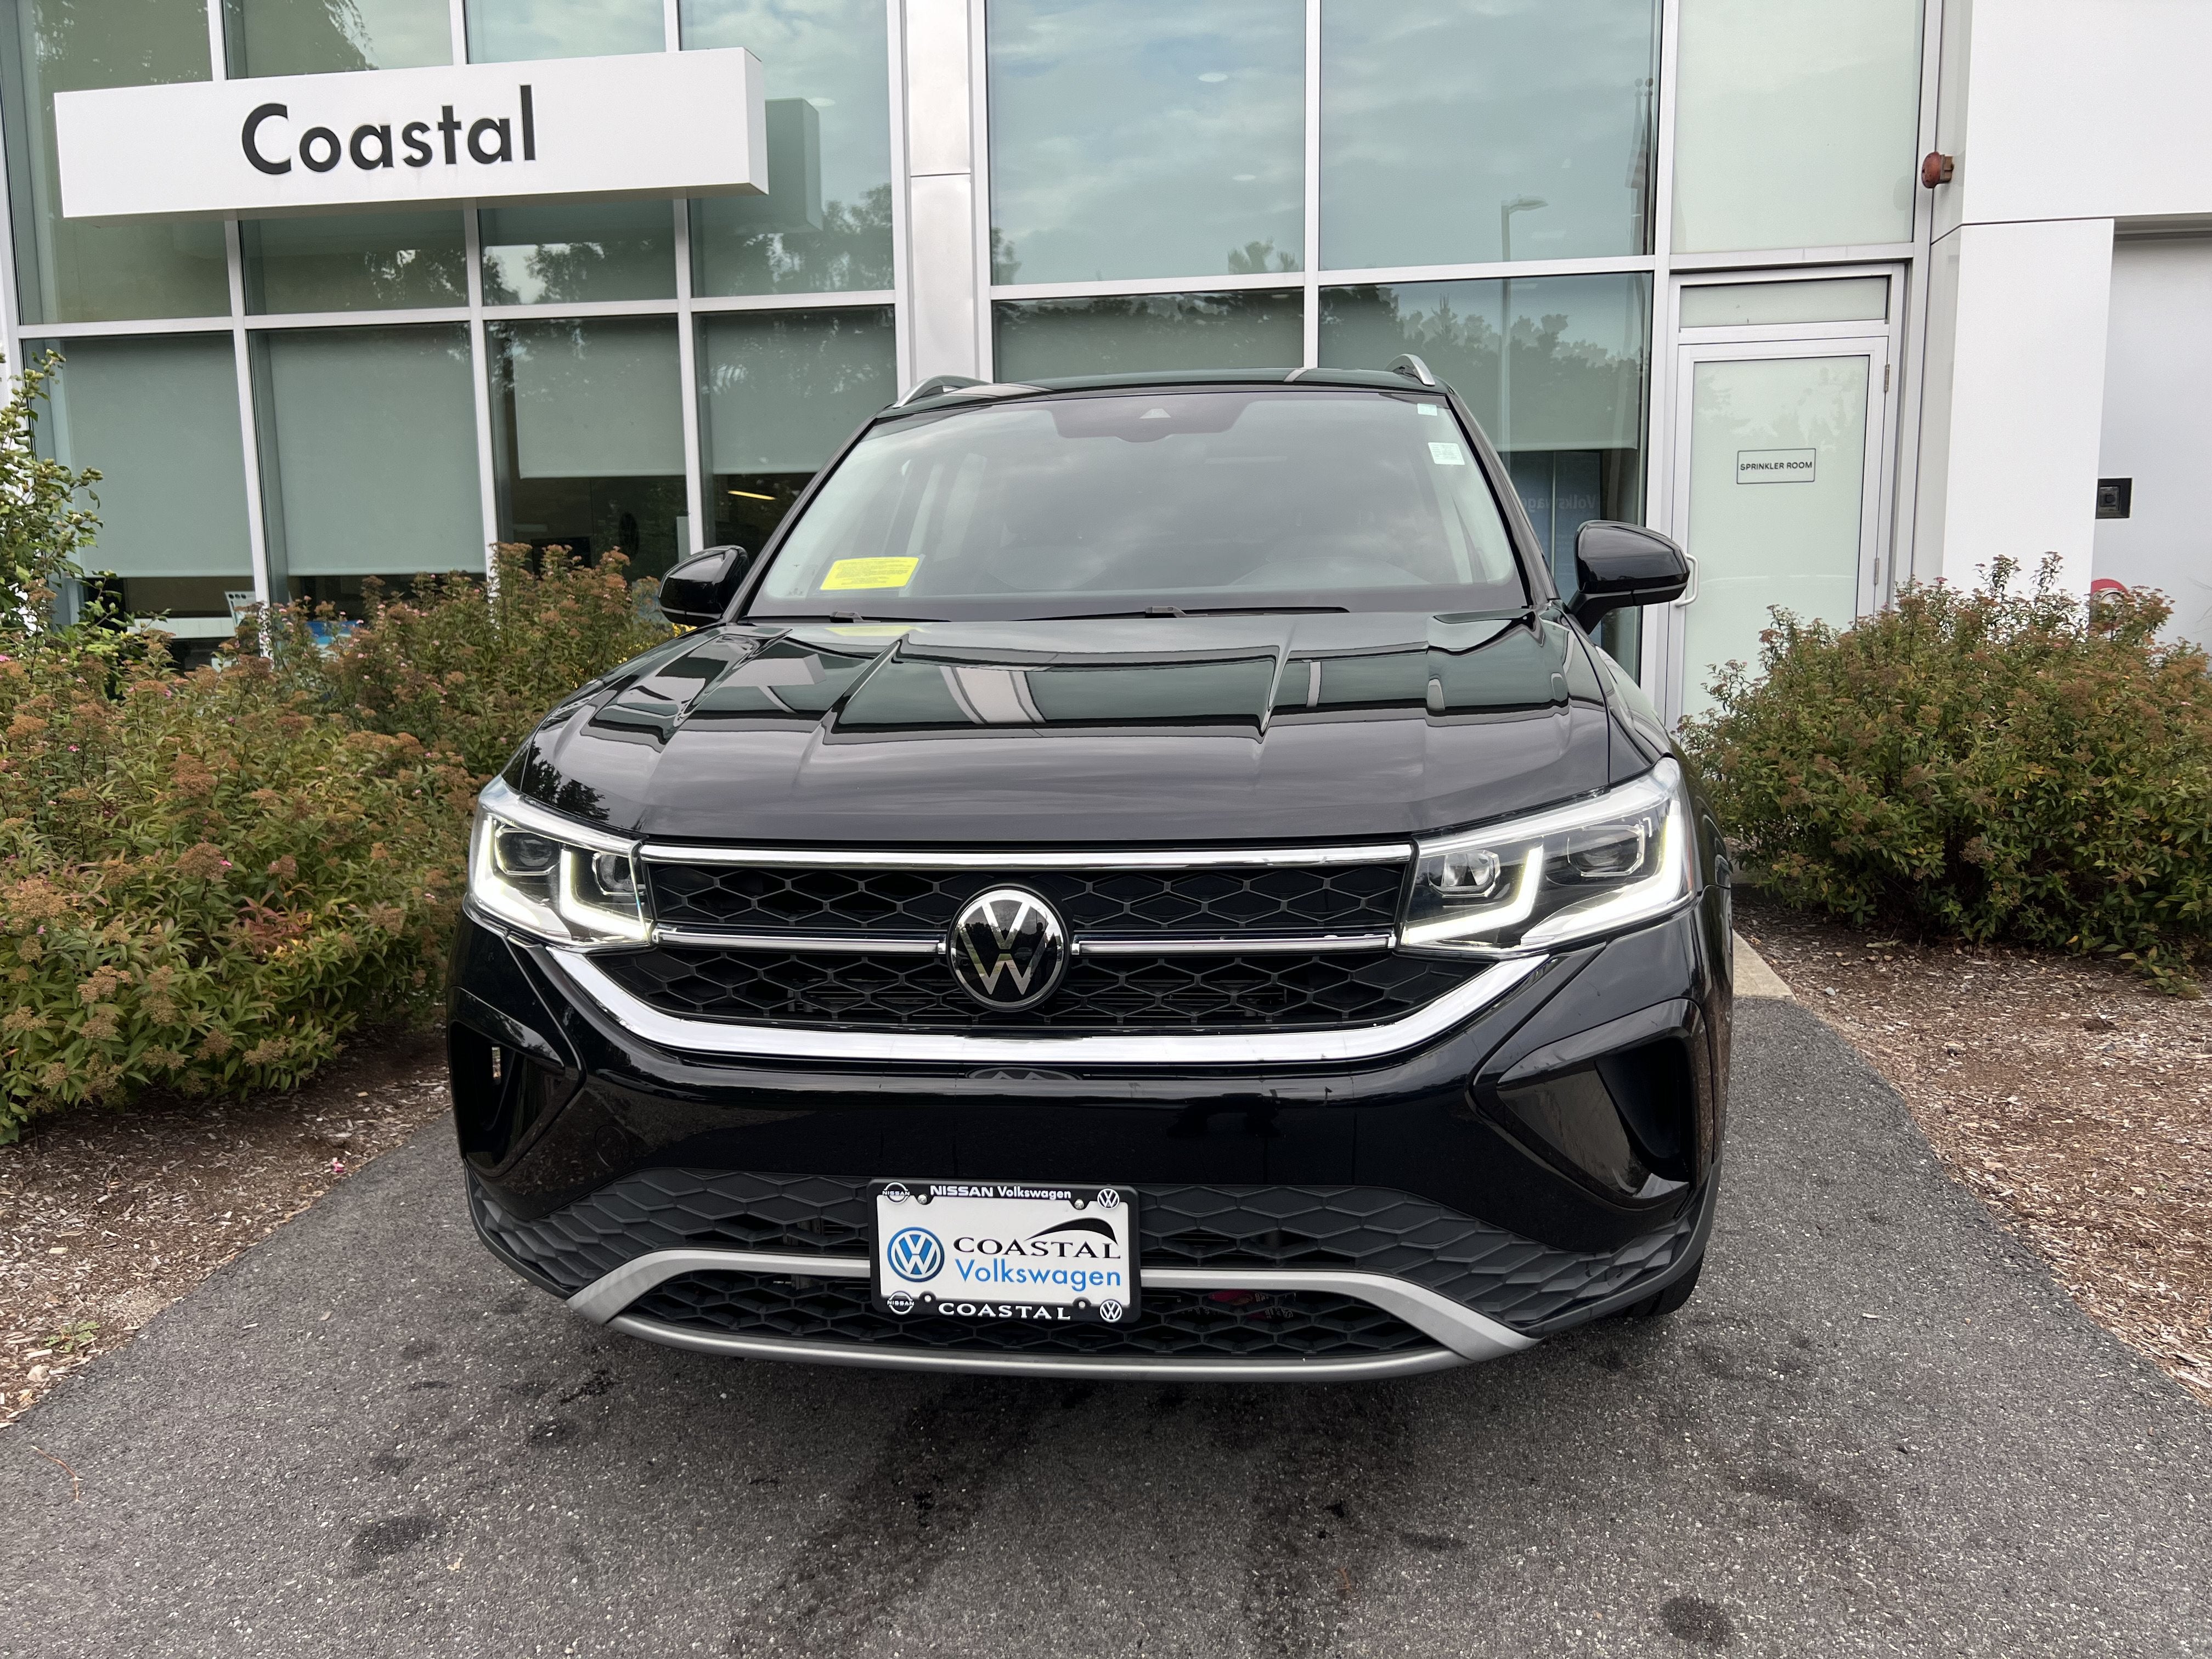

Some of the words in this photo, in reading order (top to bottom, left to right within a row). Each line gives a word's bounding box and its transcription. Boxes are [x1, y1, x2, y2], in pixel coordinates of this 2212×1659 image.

[241, 84, 536, 175] Coastal
[930, 1185, 994, 1197] NISSAN
[996, 1186, 1071, 1200] Volkswagen
[953, 1237, 1121, 1259] COASTAL
[955, 1258, 1121, 1291] Volkswagen
[938, 1303, 1071, 1321] COASTAL
